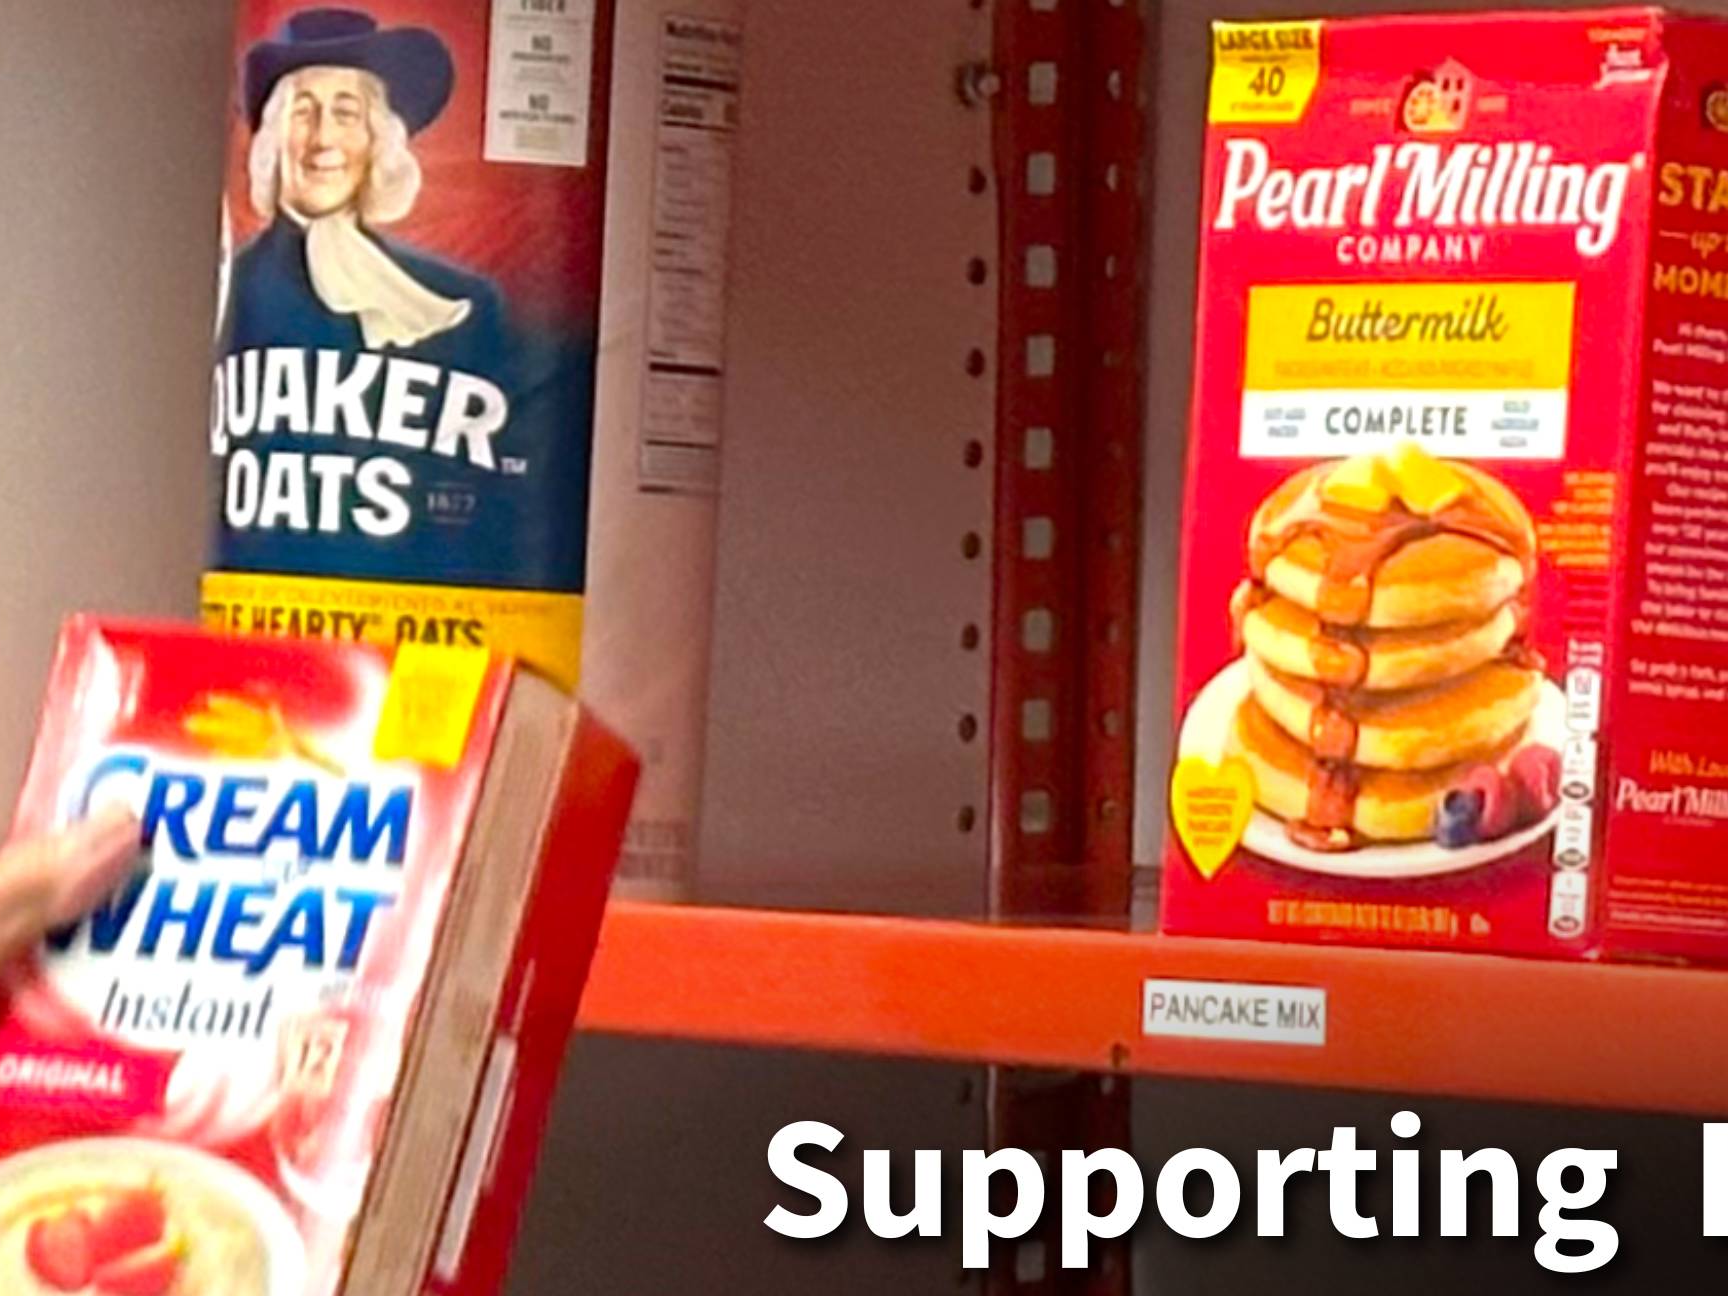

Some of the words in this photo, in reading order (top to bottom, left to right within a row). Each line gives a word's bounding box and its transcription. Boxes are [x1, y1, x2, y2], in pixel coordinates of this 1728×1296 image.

[1248, 65, 1286, 97] 40
[1214, 139, 1393, 230] Pearl
[1393, 141, 1634, 257] Milling
[1336, 235, 1487, 263] COMPANY
[1690, 231, 1720, 258] up
[1306, 294, 1511, 343] Buttermilk
[211, 346, 508, 470] QUAKER
[1324, 406, 1468, 437] COMPLETE
[225, 450, 413, 538] OATS
[251, 607, 367, 643] HEARTY
[394, 614, 487, 647] OATS
[1650, 750, 1695, 777] With
[70, 753, 414, 867] CREAM
[1616, 779, 1679, 814] Pearl
[46, 872, 398, 977] WHEAT
[98, 977, 274, 1041] Instant
[1149, 993, 1269, 1028] PANCAKE
[1275, 1001, 1322, 1030] MIX
[299, 1033, 333, 1074] 12
